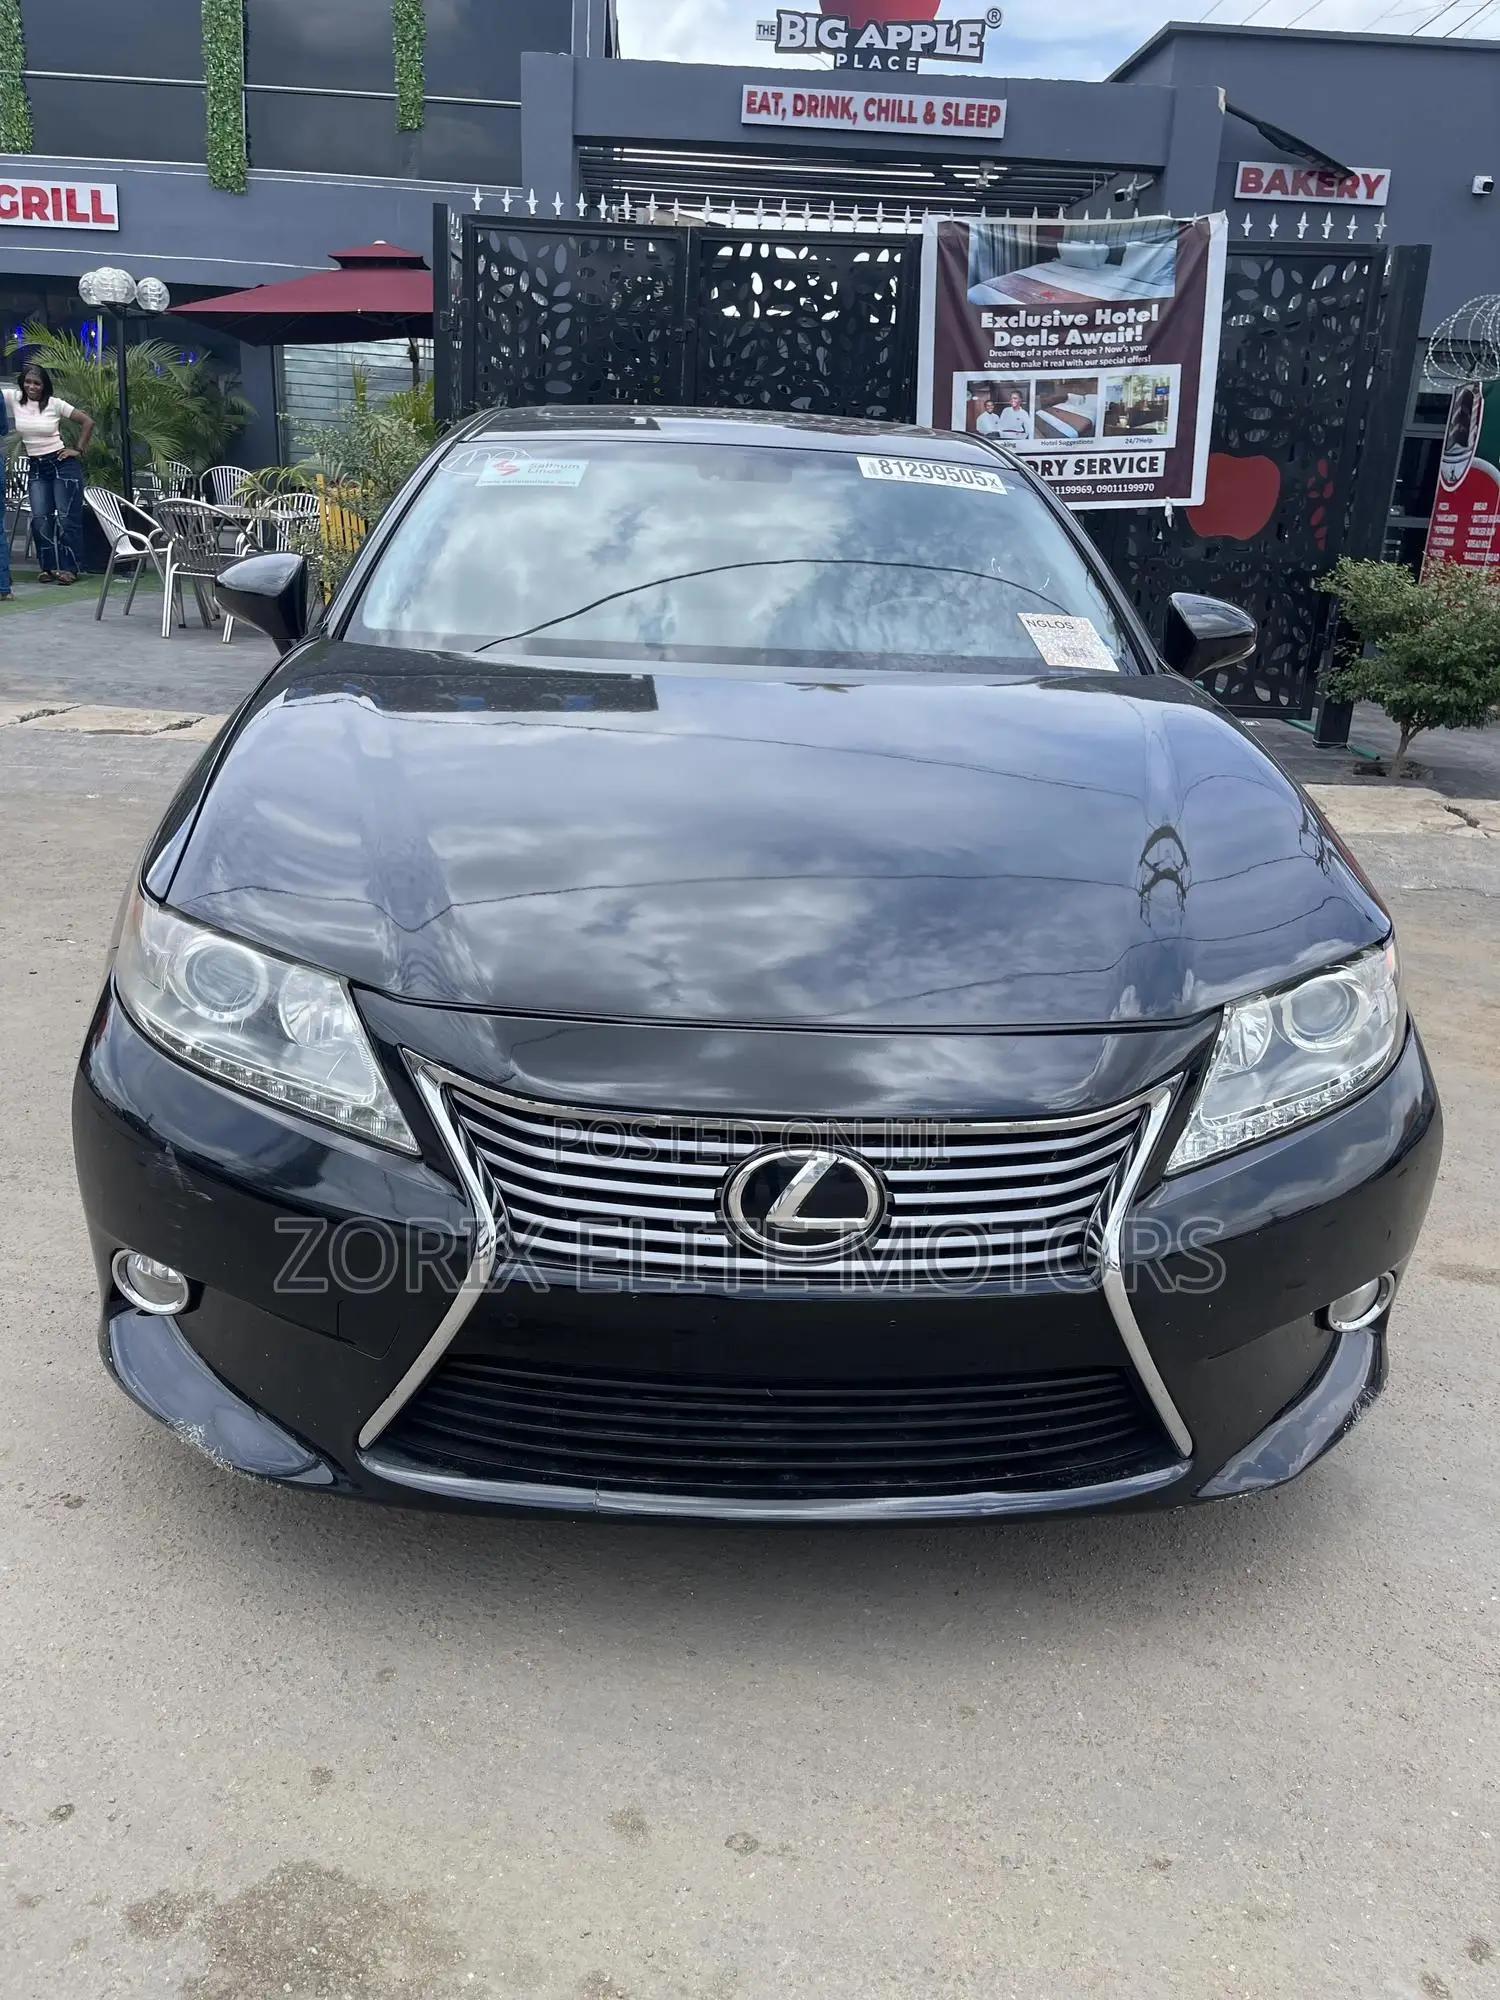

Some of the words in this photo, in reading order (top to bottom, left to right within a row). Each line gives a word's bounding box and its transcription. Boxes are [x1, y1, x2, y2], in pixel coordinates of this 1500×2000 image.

[756, 24, 776, 36] THE
[778, 13, 849, 49] BIG
[854, 22, 981, 58] APPLE
[836, 53, 917, 72] PLACE
[746, 91, 786, 120] EAT,
[792, 94, 858, 125] DRINK,
[864, 97, 917, 124] CHILL
[923, 101, 936, 125] &
[941, 102, 1001, 129] SLEEP
[1239, 166, 1386, 200] BAKERY
[0, 184, 115, 224] GRILL
[980, 309, 1088, 329] Exclusive
[1095, 303, 1159, 326] Hotel
[994, 328, 1060, 348] Deals
[1064, 324, 1143, 346] Await!
[984, 360, 1010, 369] chance
[1010, 360, 1020, 368] to
[1020, 359, 1042, 368] make
[1050, 357, 1065, 367] real
[1065, 356, 1084, 367] with
[1084, 357, 1099, 366] our
[1099, 355, 1126, 367] special
[989, 349, 1026, 358] Dreaming
[1026, 348, 1036, 357] of
[1042, 347, 1070, 358] perfect
[1071, 349, 1097, 358] escape
[1130, 344, 1149, 354] your
[1074, 456, 1159, 476] SERVICE
[1096, 483, 1155, 494] 09011199970
